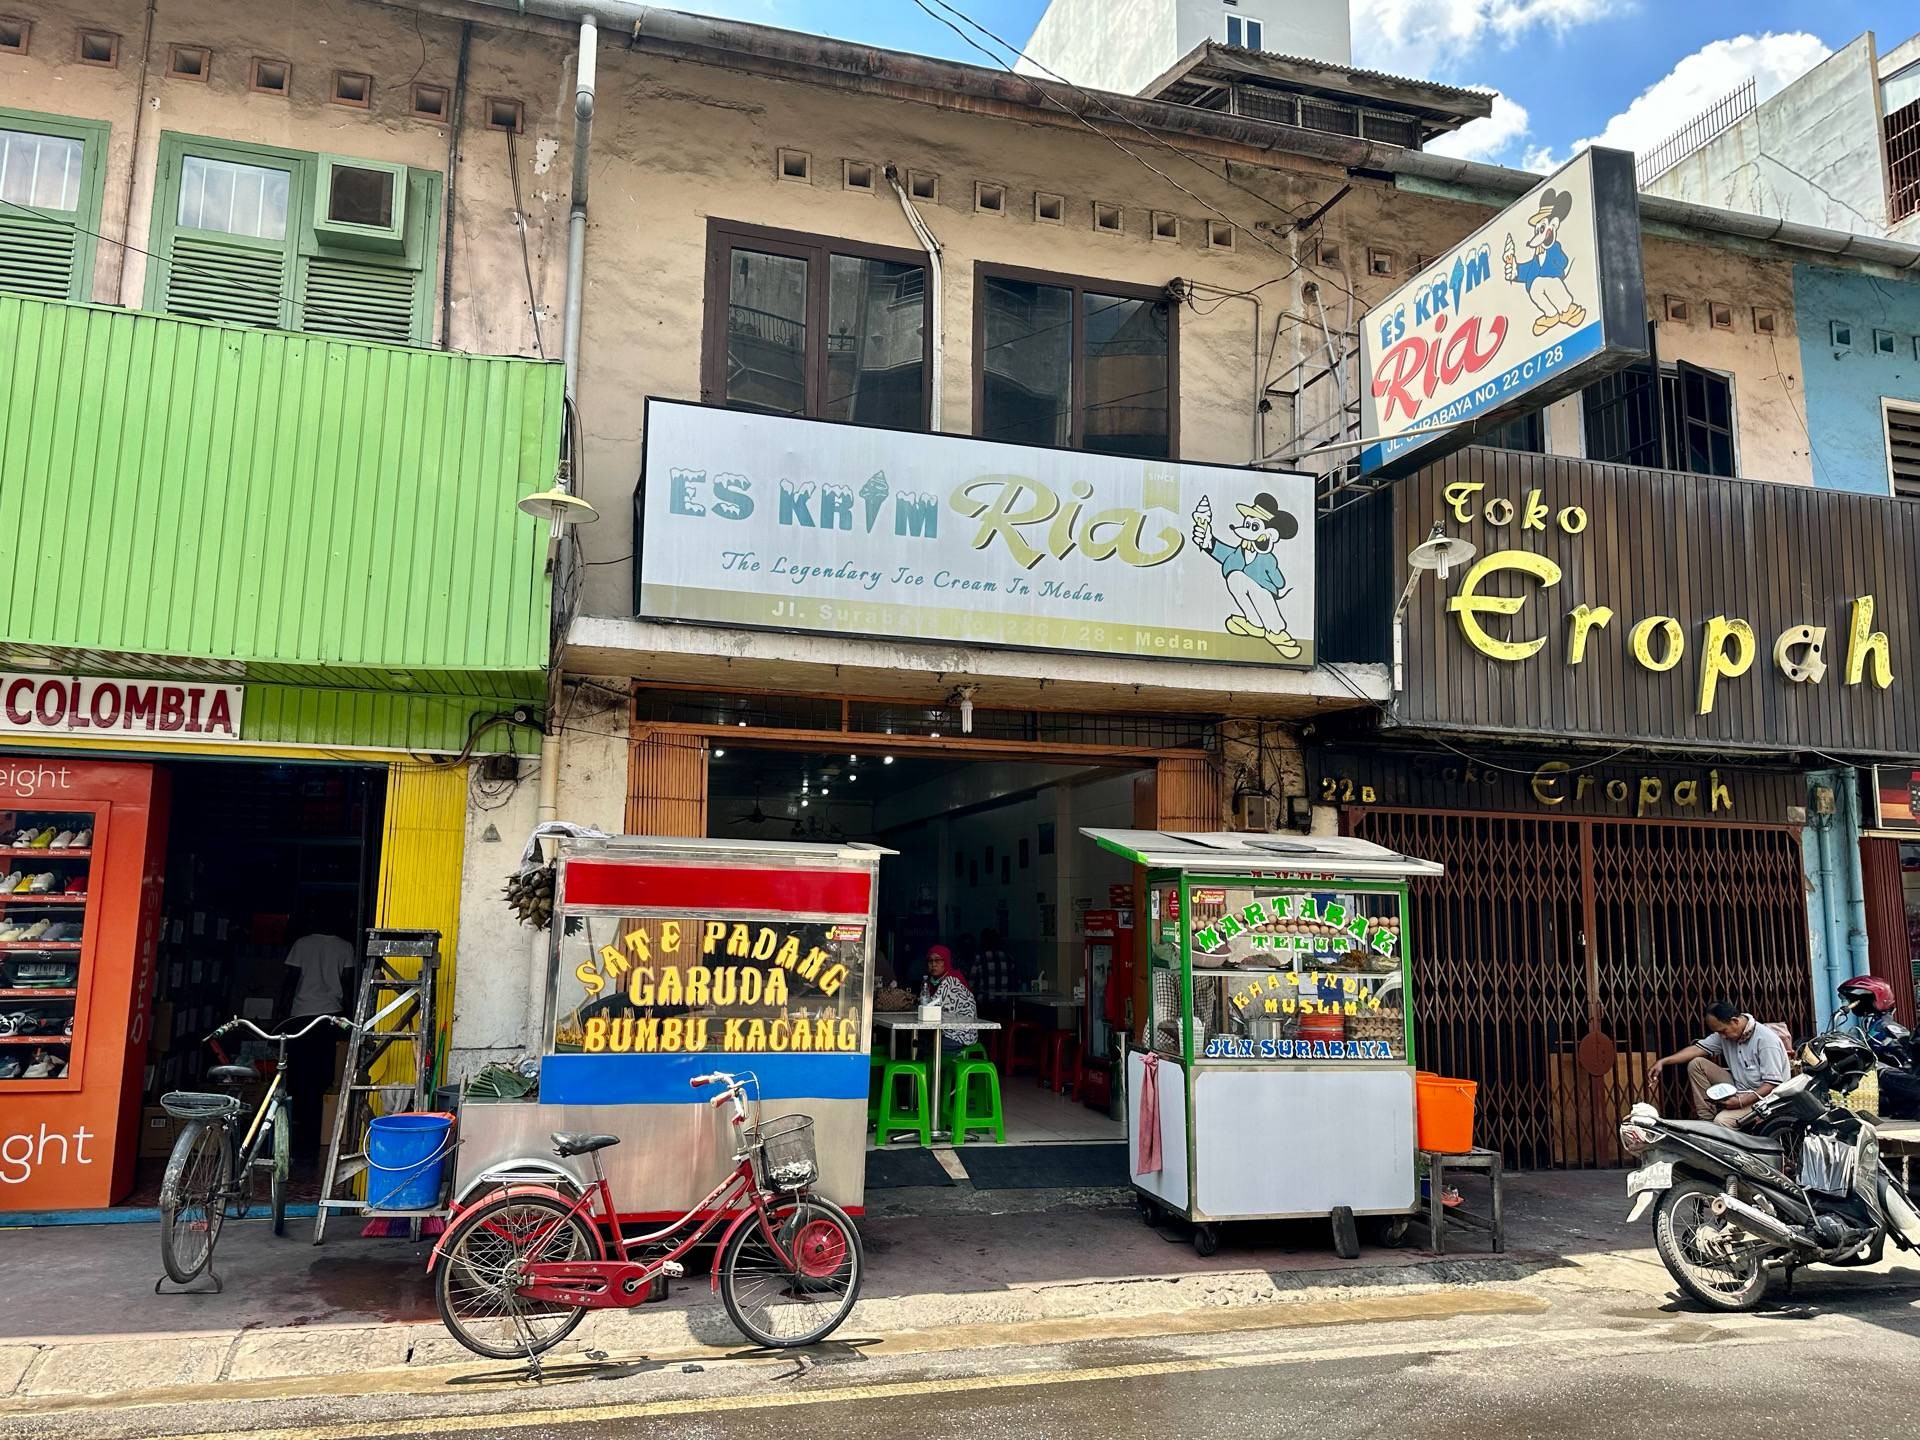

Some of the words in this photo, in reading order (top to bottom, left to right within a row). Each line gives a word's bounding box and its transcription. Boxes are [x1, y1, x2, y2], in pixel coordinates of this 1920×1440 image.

[1380, 303, 1405, 350] ES
[1371, 314, 1508, 422] Ria
[1475, 382, 1500, 407] NO.
[1503, 370, 1520, 391] 22
[1523, 363, 1534, 379] C
[1545, 346, 1564, 369] 28
[669, 467, 755, 520] ES
[949, 473, 1185, 570] Ria
[1443, 482, 1588, 534] Toko
[721, 551, 761, 572] The
[770, 556, 882, 590] Legendary
[891, 567, 924, 585] Ice
[934, 571, 997, 592] Cream
[1006, 577, 1030, 595] In
[1038, 580, 1105, 602] Medan
[1079, 626, 1106, 642] 28
[1136, 631, 1208, 651] Medan
[1446, 549, 1894, 716] Eropah
[6, 678, 232, 734] COLOMBIA
[1531, 761, 1733, 817] Eropah
[1195, 896, 1397, 958] MARTABAK
[1252, 935, 1351, 953] TELUR
[575, 922, 681, 996] SATE
[703, 922, 849, 997] PADANG
[629, 966, 788, 1007] GARUDA
[1233, 971, 1300, 1010] KHAS
[1310, 971, 1381, 1013] INDIA
[1264, 998, 1358, 1016] MUSLIM
[584, 1017, 708, 1053] BUMBU
[723, 1017, 857, 1052] KACANG
[1261, 1039, 1393, 1058] SURABAYA
[0, 1123, 94, 1184] ght
